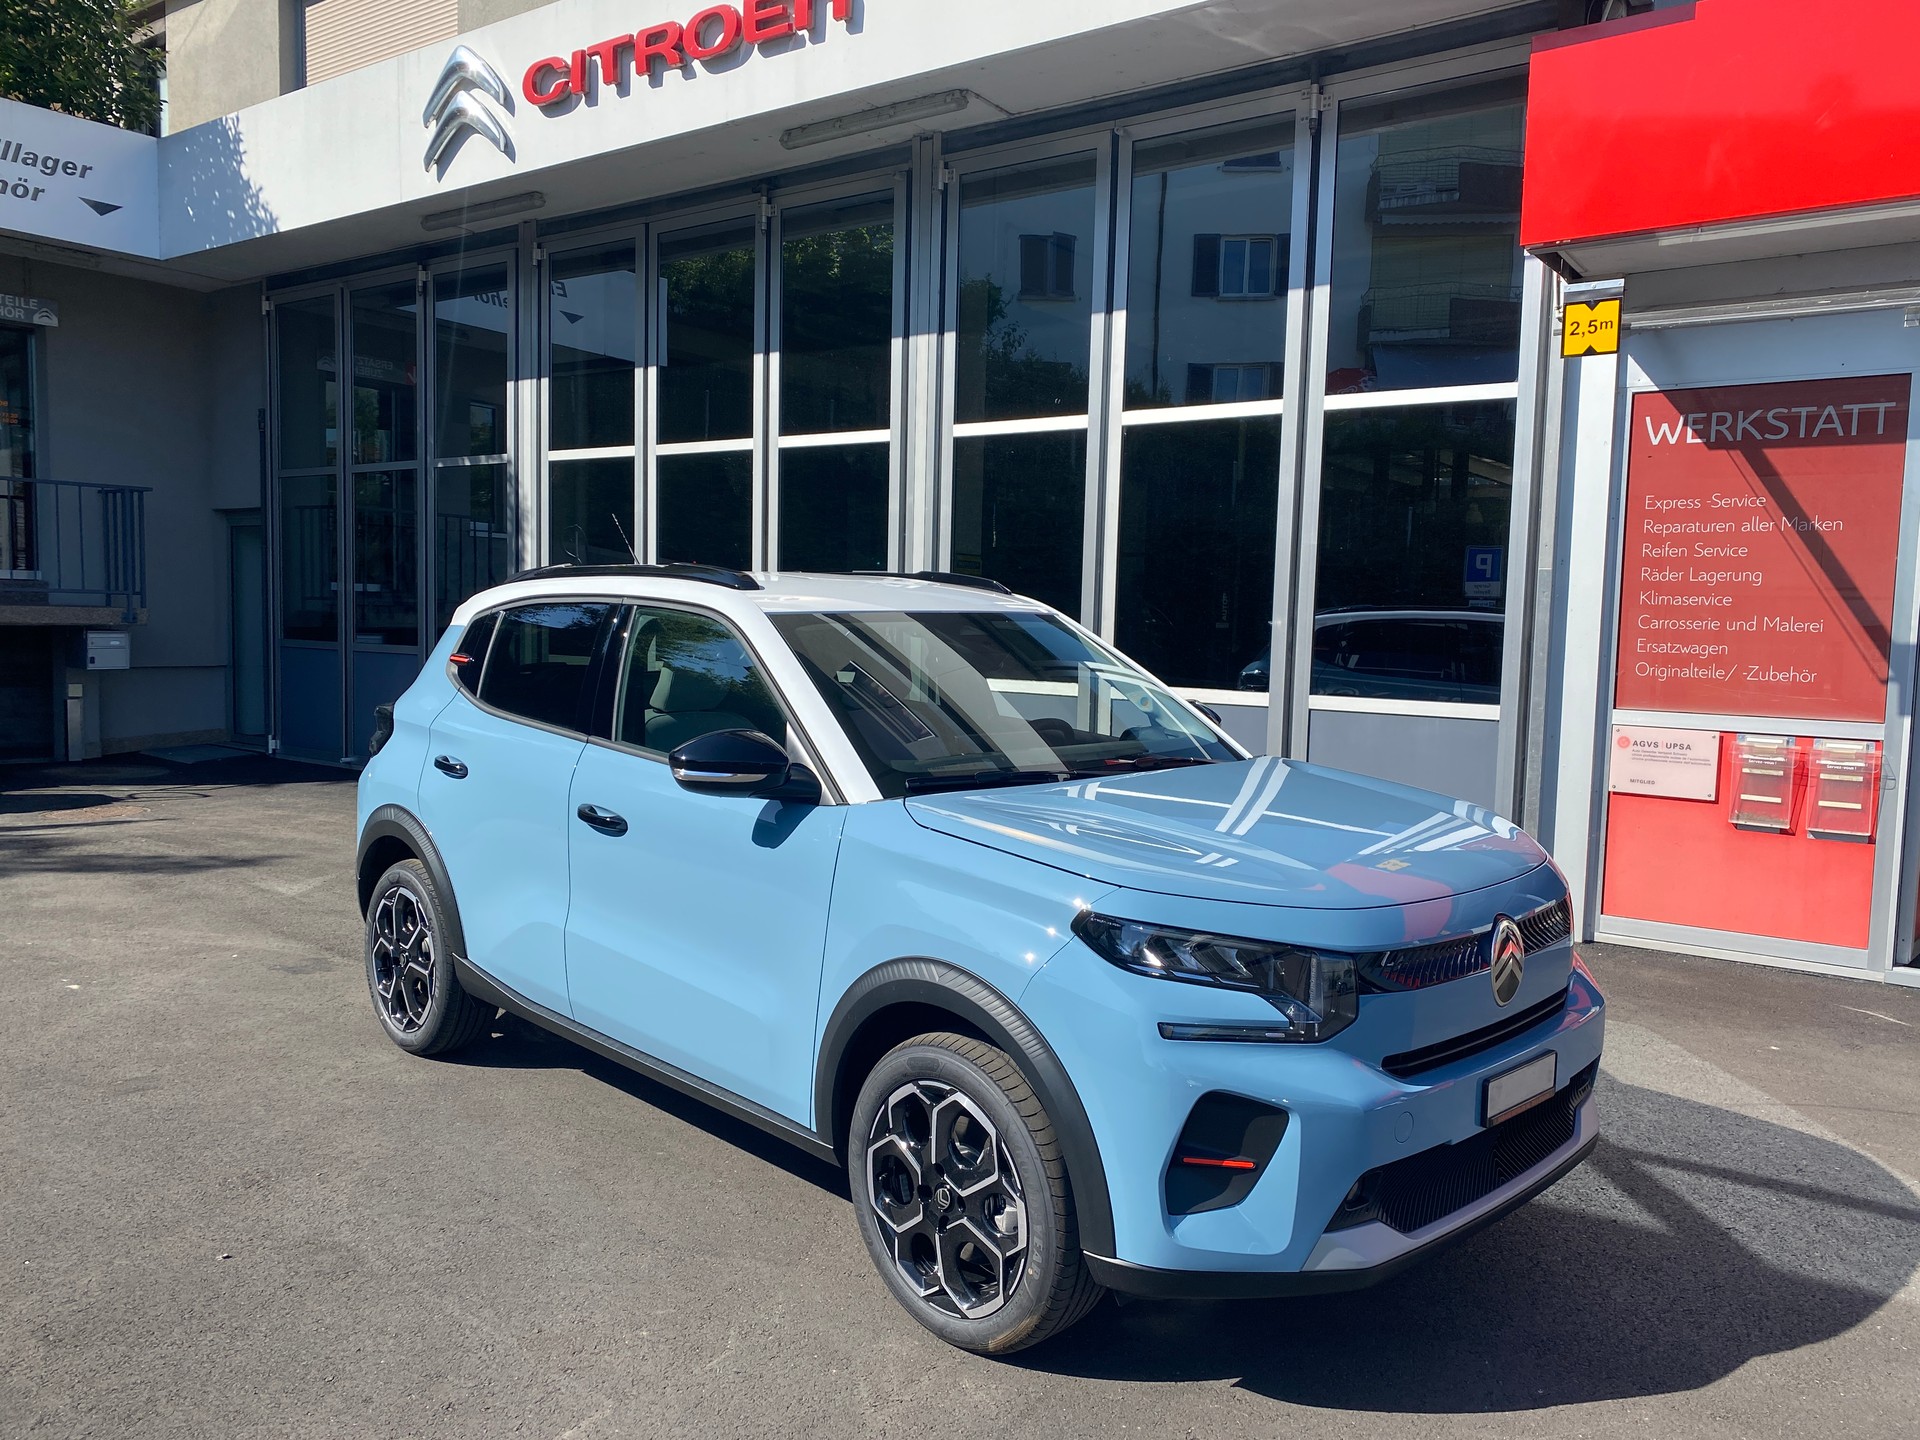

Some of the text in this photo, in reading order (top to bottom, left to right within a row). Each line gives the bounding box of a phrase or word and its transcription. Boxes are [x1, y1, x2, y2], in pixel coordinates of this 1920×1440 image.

[0, 139, 93, 179] llager
[1569, 319, 1614, 338] 2,5m
[1645, 402, 1896, 446] WERKSTATT
[1644, 493, 1767, 513] Express -Service
[1643, 515, 1843, 537] Reparaturen aller Marken
[1642, 542, 1748, 558] Reifen Service
[1641, 566, 1763, 586] Räder Lagerung
[1639, 590, 1733, 606] Klimaservice
[1637, 615, 1824, 633] Carrosserie und Malerei
[1637, 638, 1728, 658] Ersatzwagen
[1742, 665, 1817, 682] -Zubehör
[1632, 740, 1692, 750] AGVS UPSA
